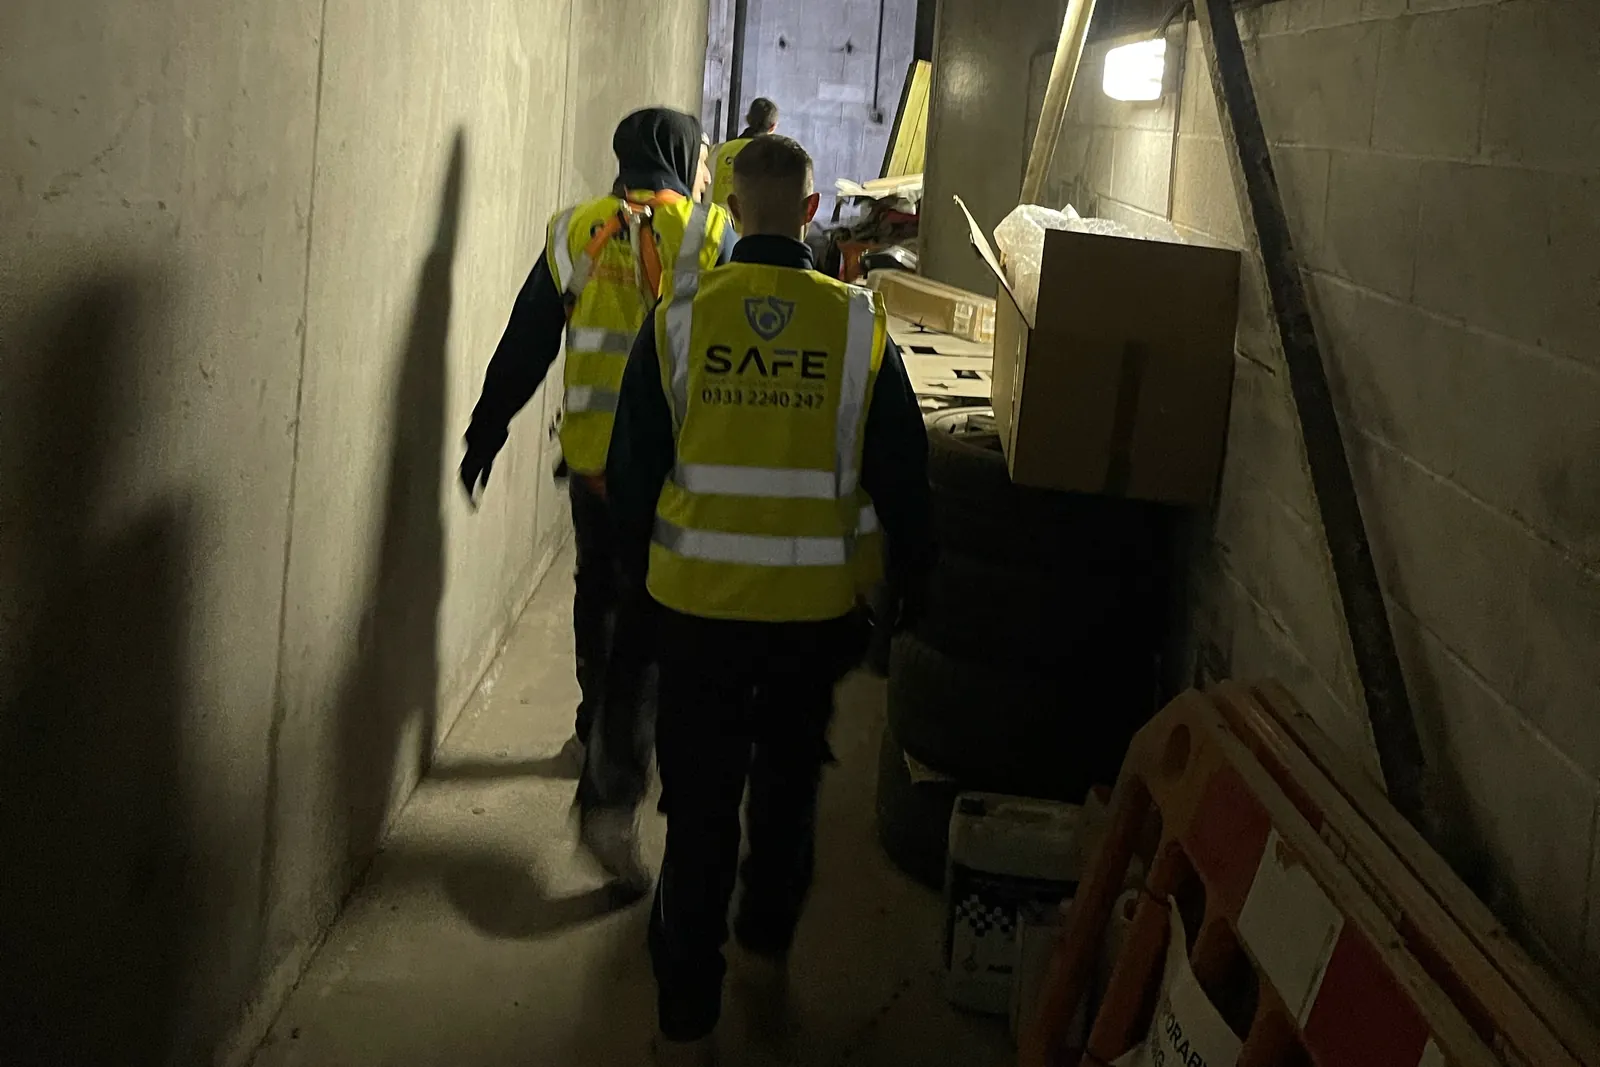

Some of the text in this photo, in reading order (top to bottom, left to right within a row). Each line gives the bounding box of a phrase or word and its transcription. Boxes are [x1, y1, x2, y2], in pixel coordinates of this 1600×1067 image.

[703, 344, 829, 380] SAFE
[701, 387, 825, 410] 0333 2240 247
